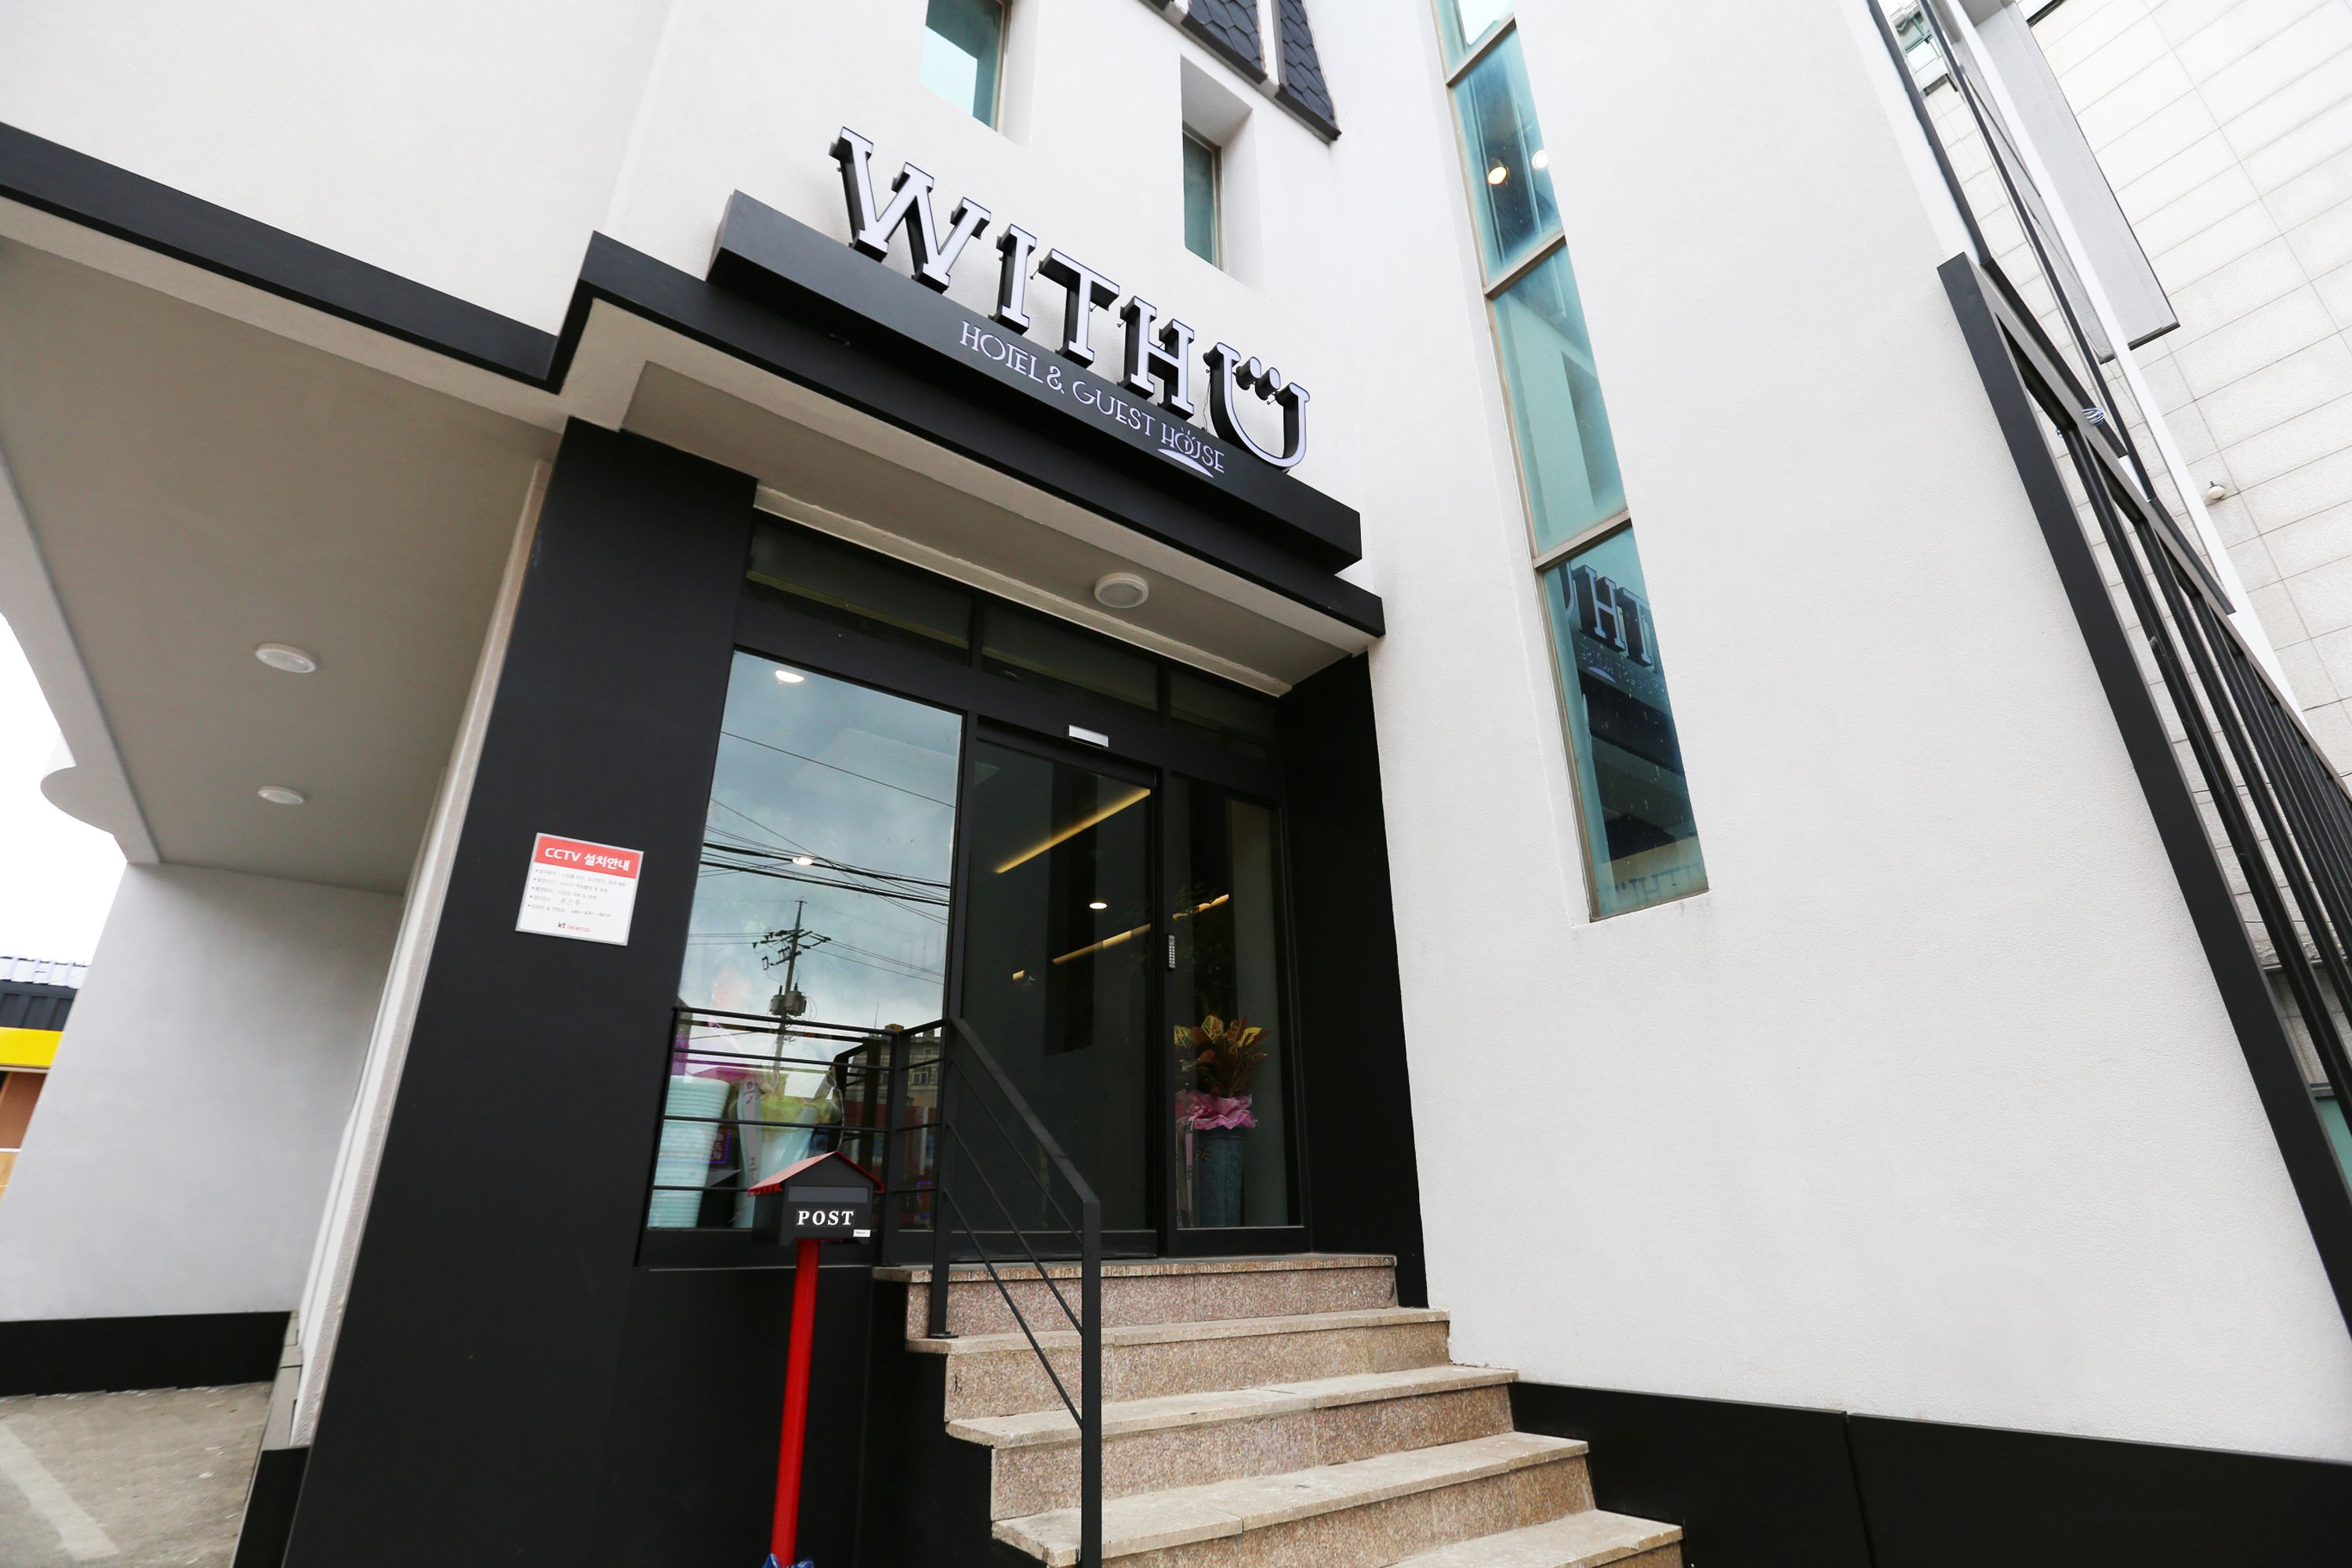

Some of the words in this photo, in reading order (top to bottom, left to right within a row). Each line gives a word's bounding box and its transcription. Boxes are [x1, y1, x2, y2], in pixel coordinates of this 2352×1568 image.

[960, 320, 1044, 384] HOTEL
[1047, 365, 1065, 394] &
[1072, 380, 1156, 437] GUEST
[544, 847, 582, 862] CCTV
[583, 853, 630, 872] 설치안내
[797, 1210, 855, 1226] POST
